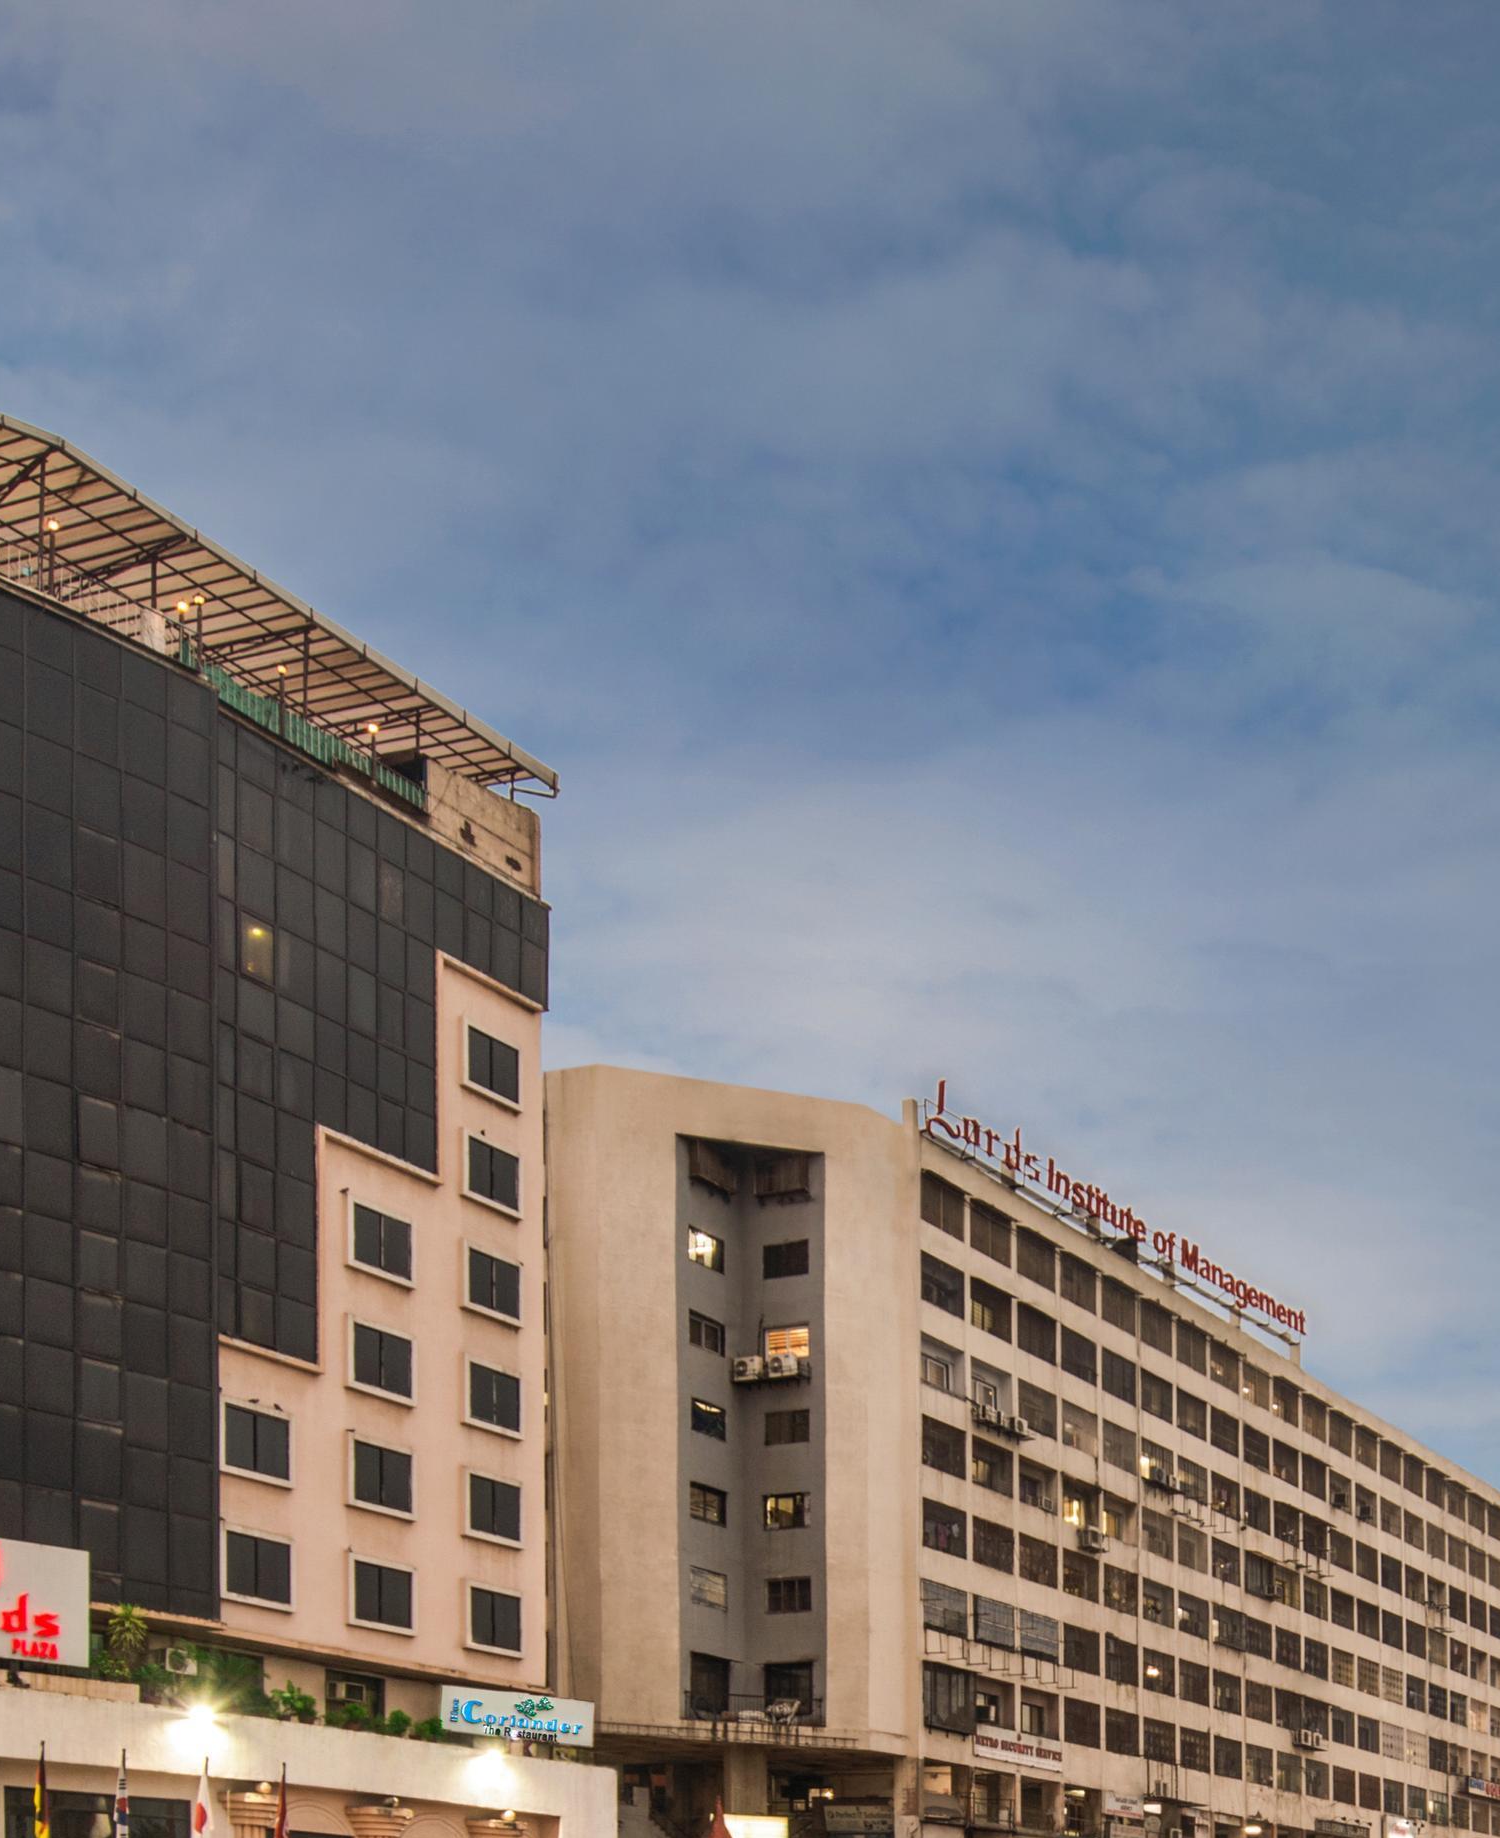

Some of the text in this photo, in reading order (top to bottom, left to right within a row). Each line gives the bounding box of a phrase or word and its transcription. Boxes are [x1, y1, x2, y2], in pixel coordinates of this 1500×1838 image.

[926, 1079, 1307, 1335] Lords Institute of Management
[12, 1638, 58, 1660] PLAZA
[461, 1699, 584, 1735] Coriander
[483, 1724, 558, 1743] The Rstaurant
